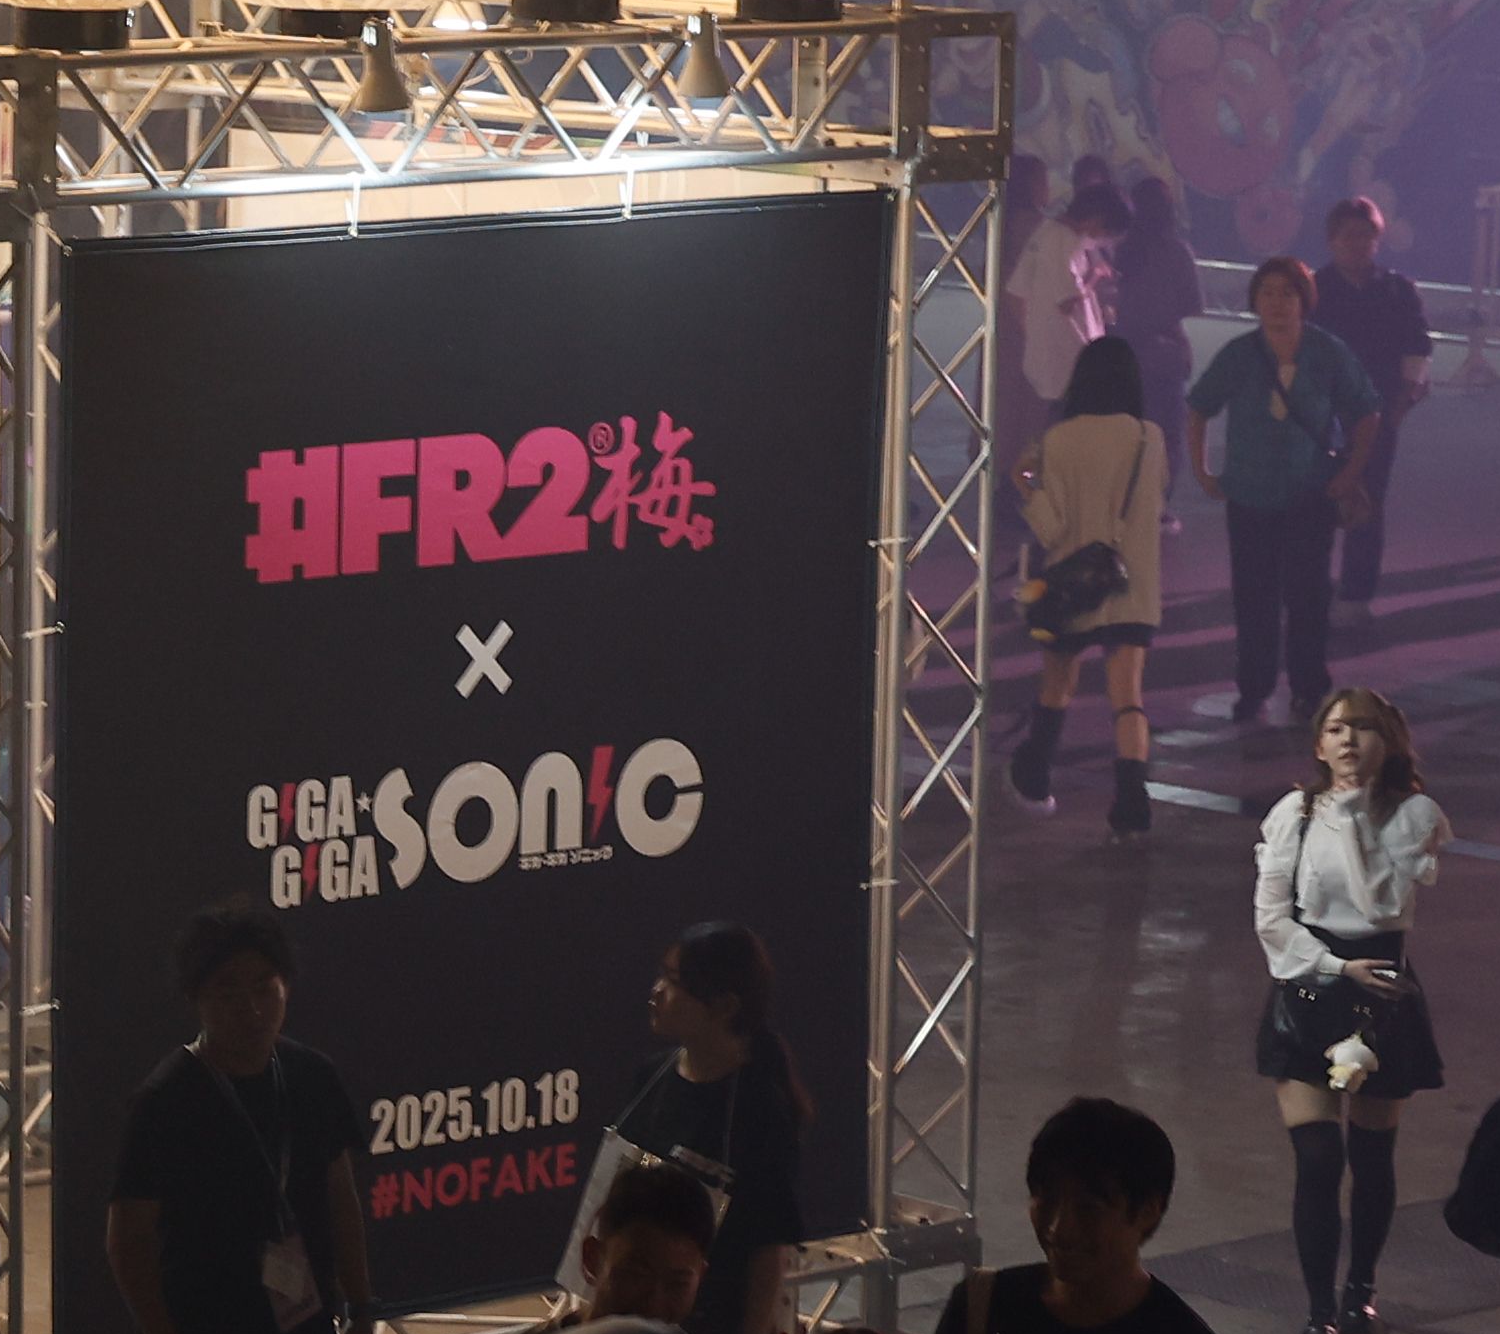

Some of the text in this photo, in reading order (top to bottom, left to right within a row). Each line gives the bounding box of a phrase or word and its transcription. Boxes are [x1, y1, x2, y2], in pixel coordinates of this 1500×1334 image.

[246, 775, 359, 850] GIGA
[270, 834, 382, 910] GIGA
[370, 1068, 580, 1156] 2025.10.18
[371, 1143, 578, 1220] #NOFAKE
